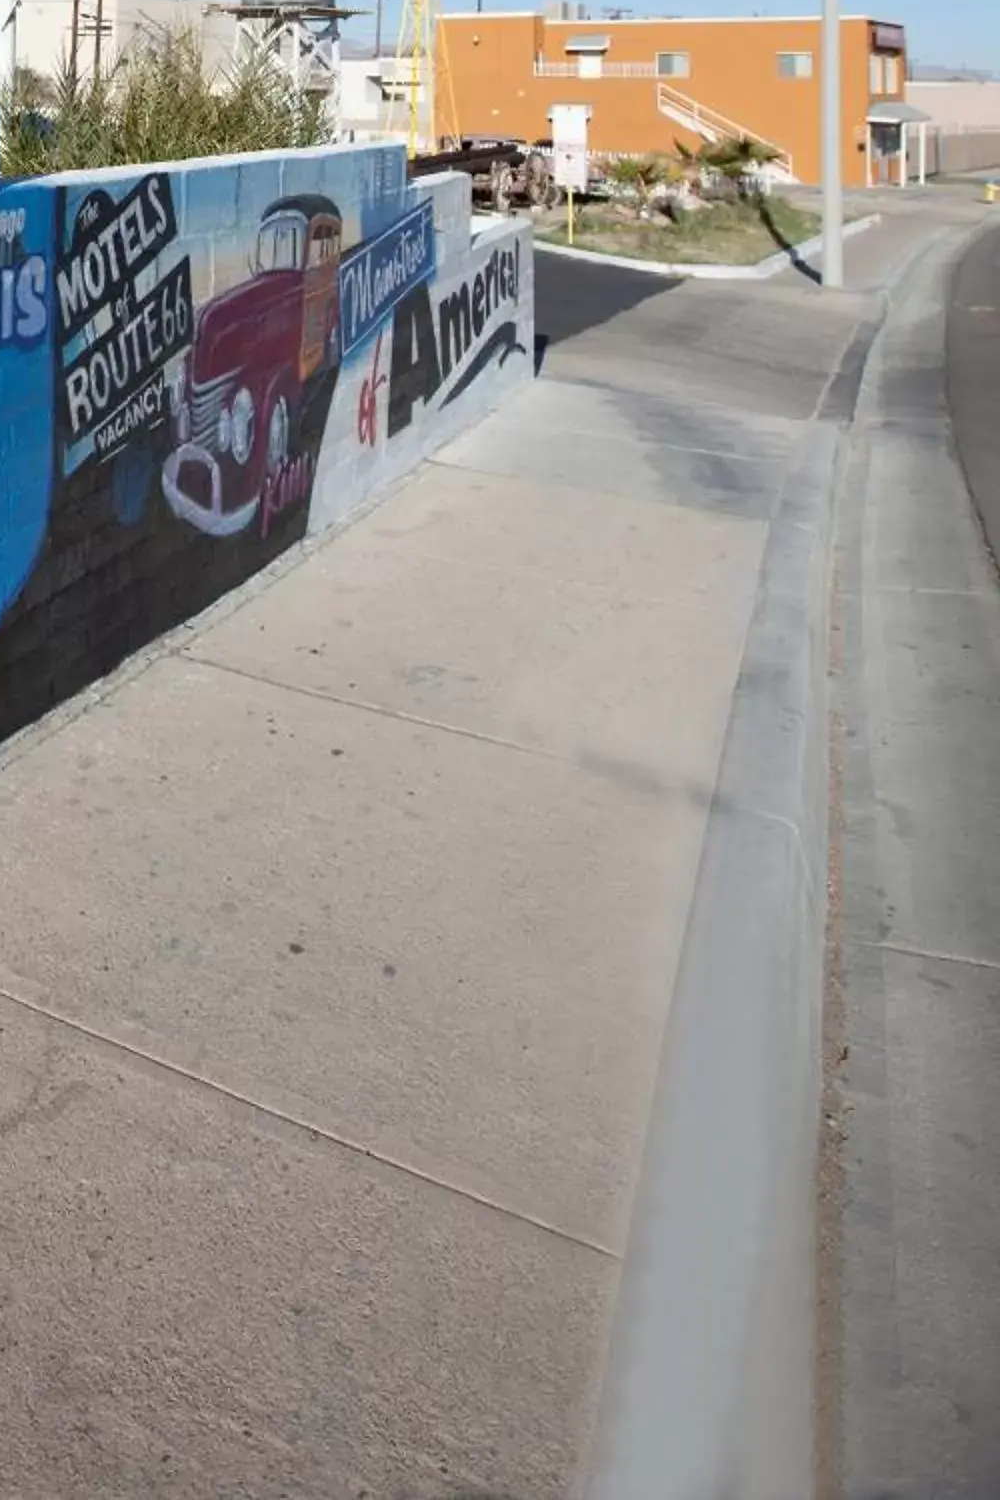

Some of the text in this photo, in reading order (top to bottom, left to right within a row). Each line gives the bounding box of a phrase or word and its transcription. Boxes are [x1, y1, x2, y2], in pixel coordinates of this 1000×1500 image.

[56, 177, 167, 329] MOTELS
[66, 275, 188, 436] ROUTE 66
[97, 374, 164, 449] VACANCY
